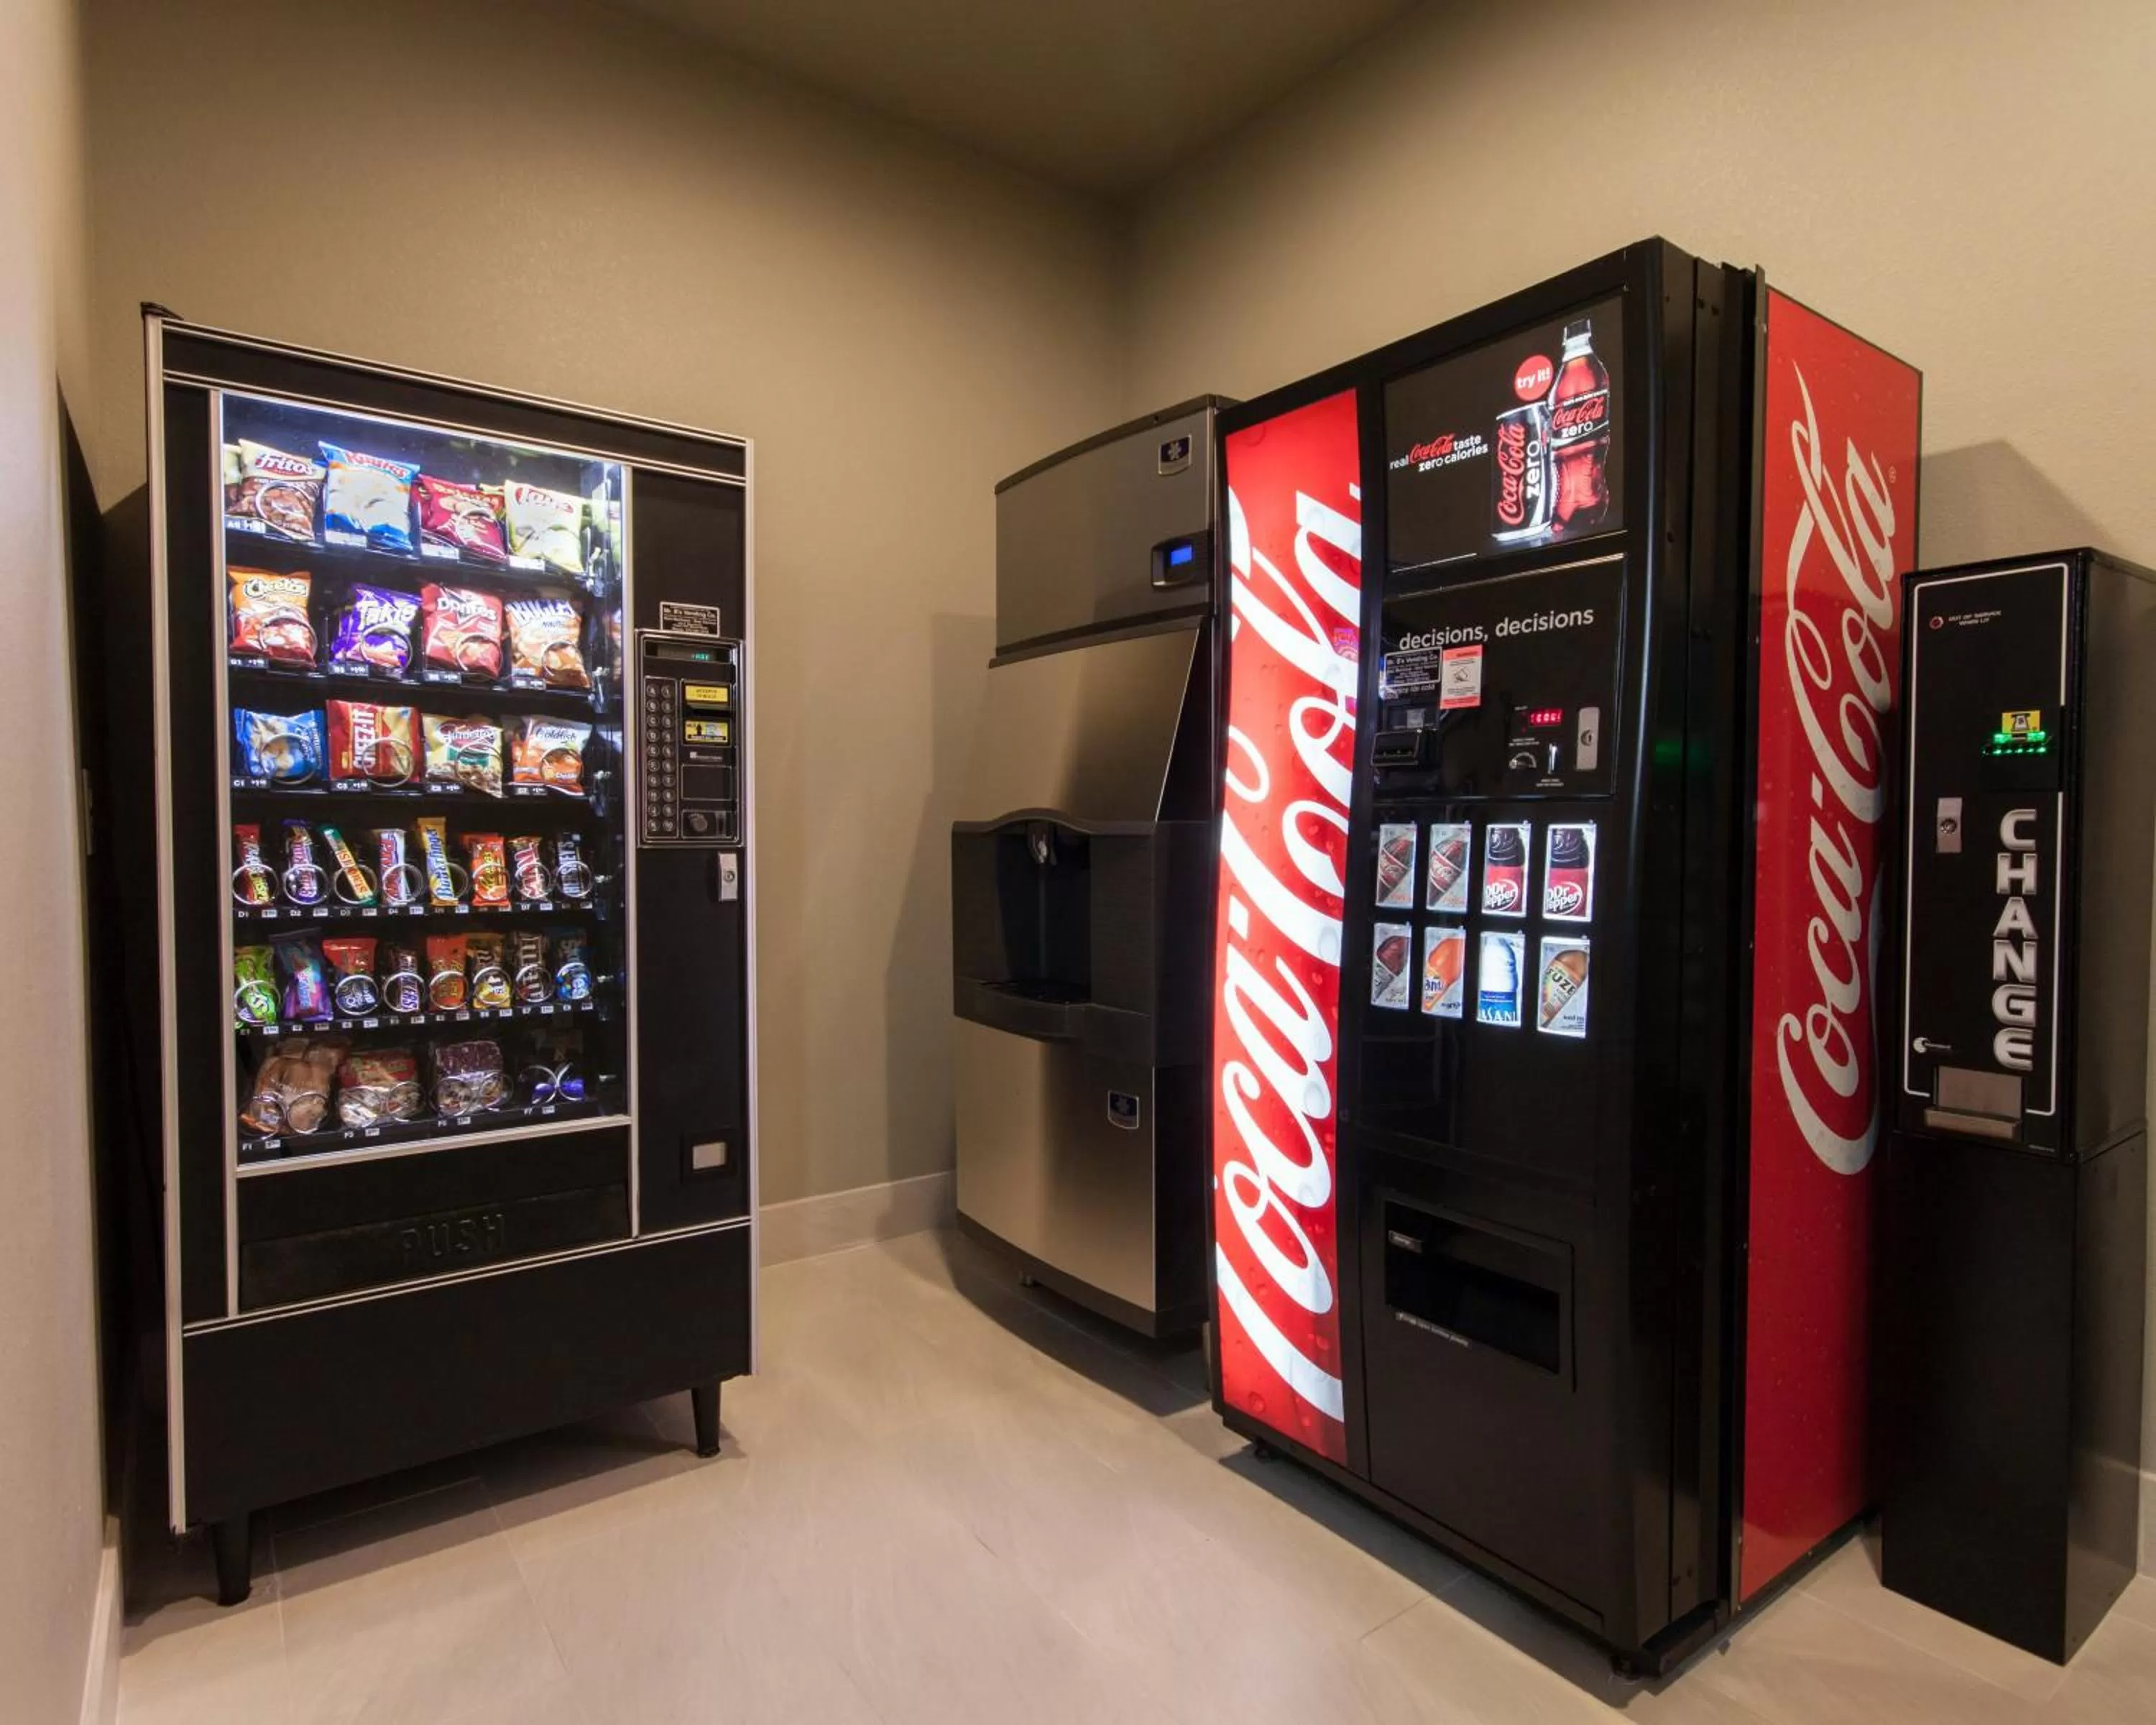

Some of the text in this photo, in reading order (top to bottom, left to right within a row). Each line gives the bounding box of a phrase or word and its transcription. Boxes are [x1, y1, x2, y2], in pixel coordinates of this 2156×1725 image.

[1516, 367, 1550, 390] try it!
[1562, 421, 1593, 438] zero
[1389, 454, 1409, 470] real
[1454, 435, 1481, 451] taste
[1418, 443, 1488, 472] zero calories
[1526, 440, 1541, 500] zero
[356, 599, 419, 630] Takis
[436, 596, 497, 621] Doritos
[1399, 608, 1595, 651] decisions, decisions
[1777, 359, 1895, 1177] Coca-Cola
[426, 827, 454, 898] Butterfinger
[1991, 809, 2039, 1071] CHANGE
